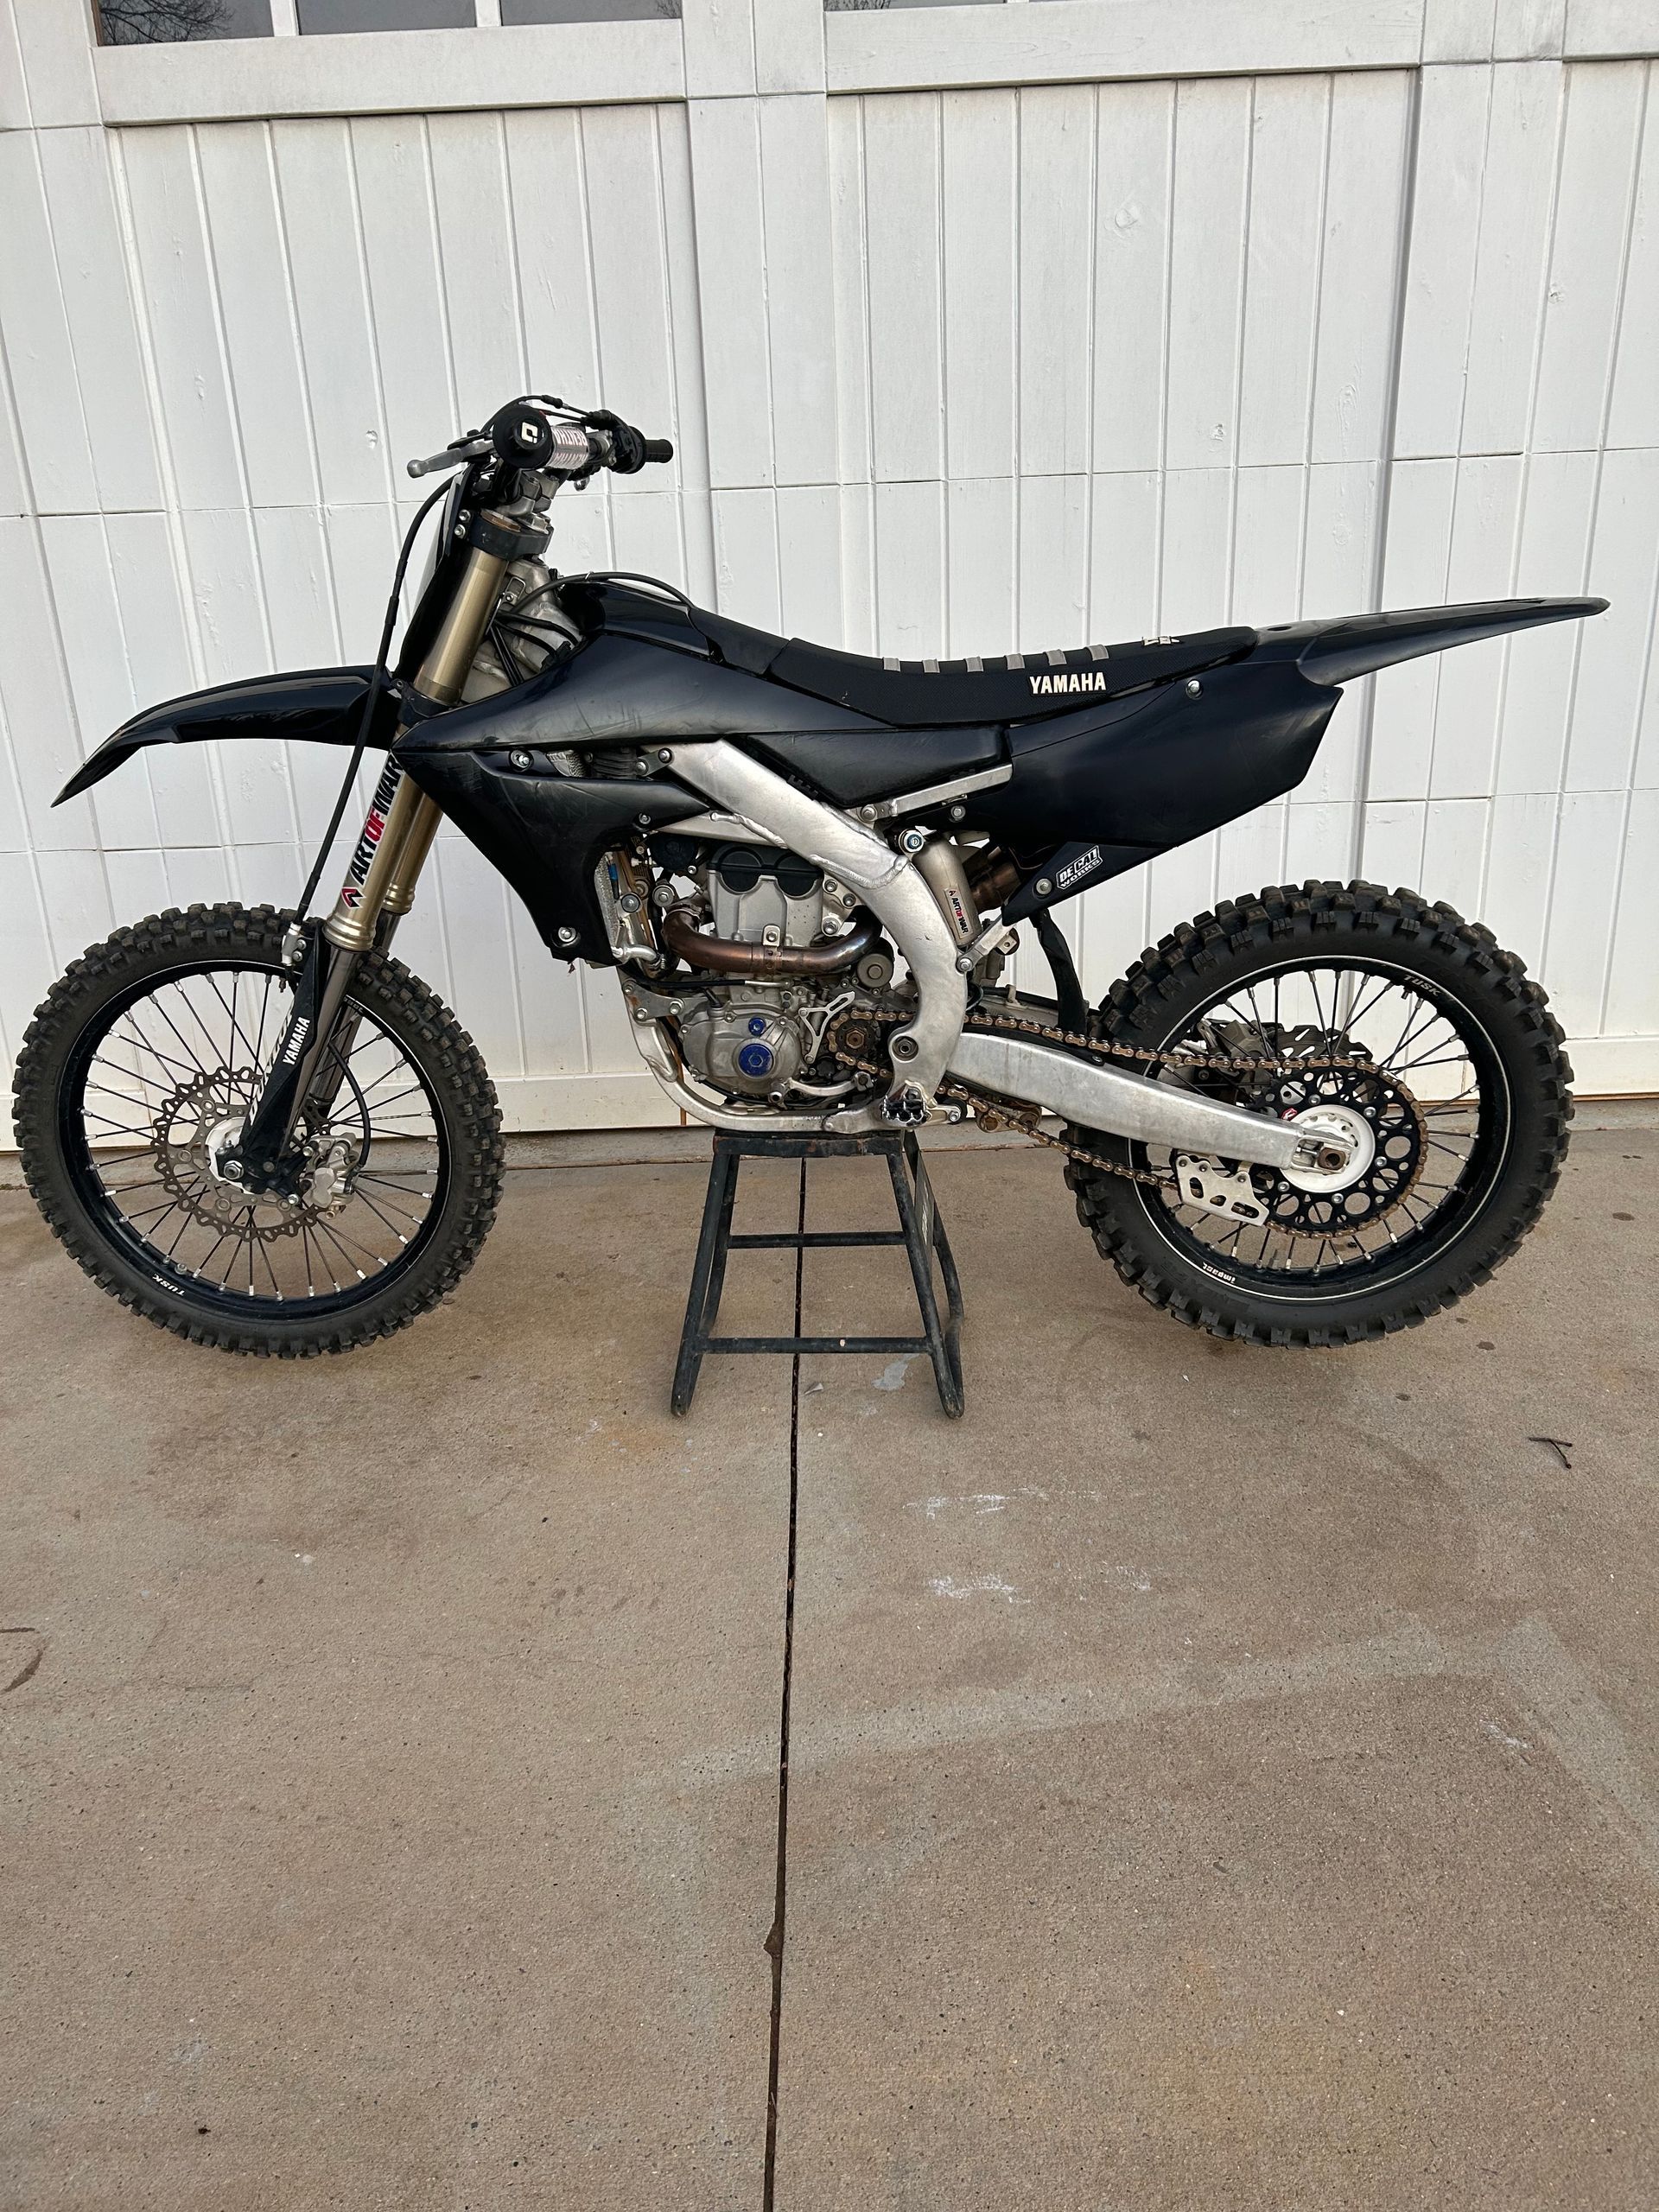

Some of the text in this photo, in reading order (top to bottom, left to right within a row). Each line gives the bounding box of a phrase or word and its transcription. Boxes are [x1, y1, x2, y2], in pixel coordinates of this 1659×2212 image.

[550, 427, 588, 446] RENTHA
[1029, 671, 1106, 694] YAMAHA
[1059, 849, 1097, 882] DECAL
[1060, 859, 1100, 887] WORKS
[1404, 975, 1441, 996] TUSK
[282, 1016, 311, 1065] YAMAHA
[152, 1273, 185, 1296] TUSK
[1202, 1262, 1236, 1284] impact
